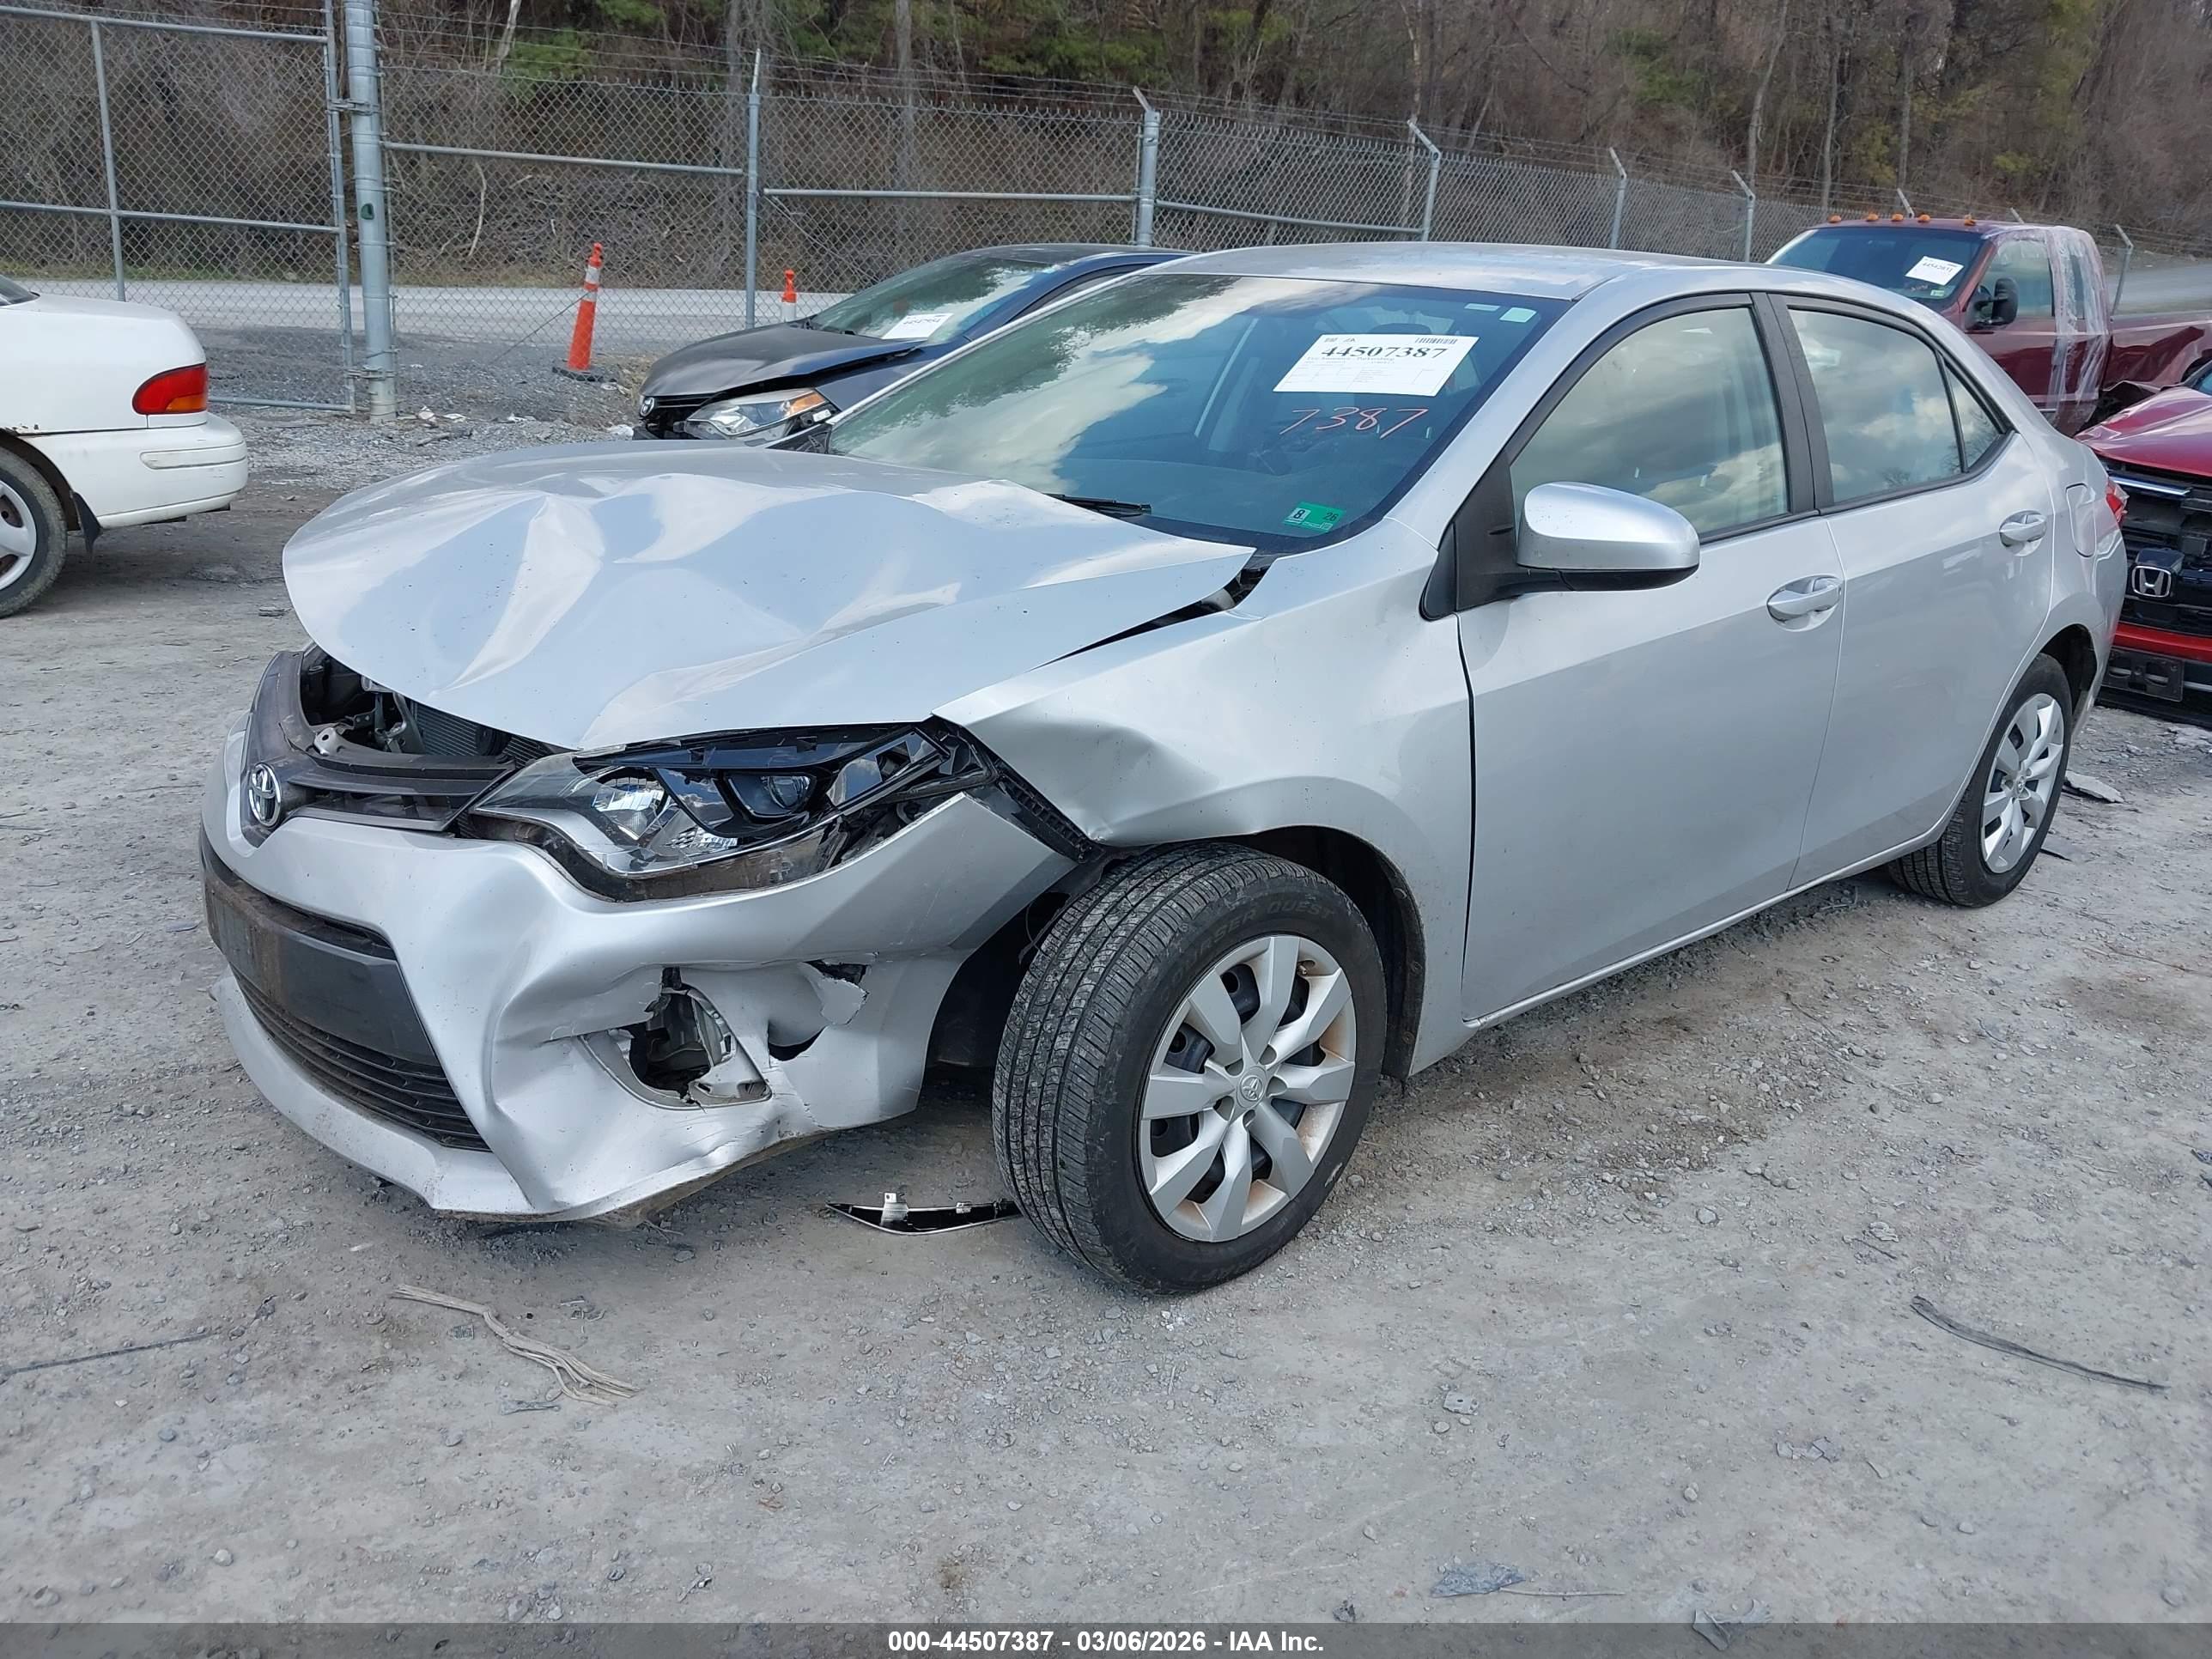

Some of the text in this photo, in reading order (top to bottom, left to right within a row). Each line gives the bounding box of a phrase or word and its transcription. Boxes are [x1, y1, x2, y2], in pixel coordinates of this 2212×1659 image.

[1321, 346, 1449, 359] 44507387
[1279, 406, 1429, 439] 7387
[1292, 509, 1306, 520] 8
[1267, 899, 1335, 920] QUEST
